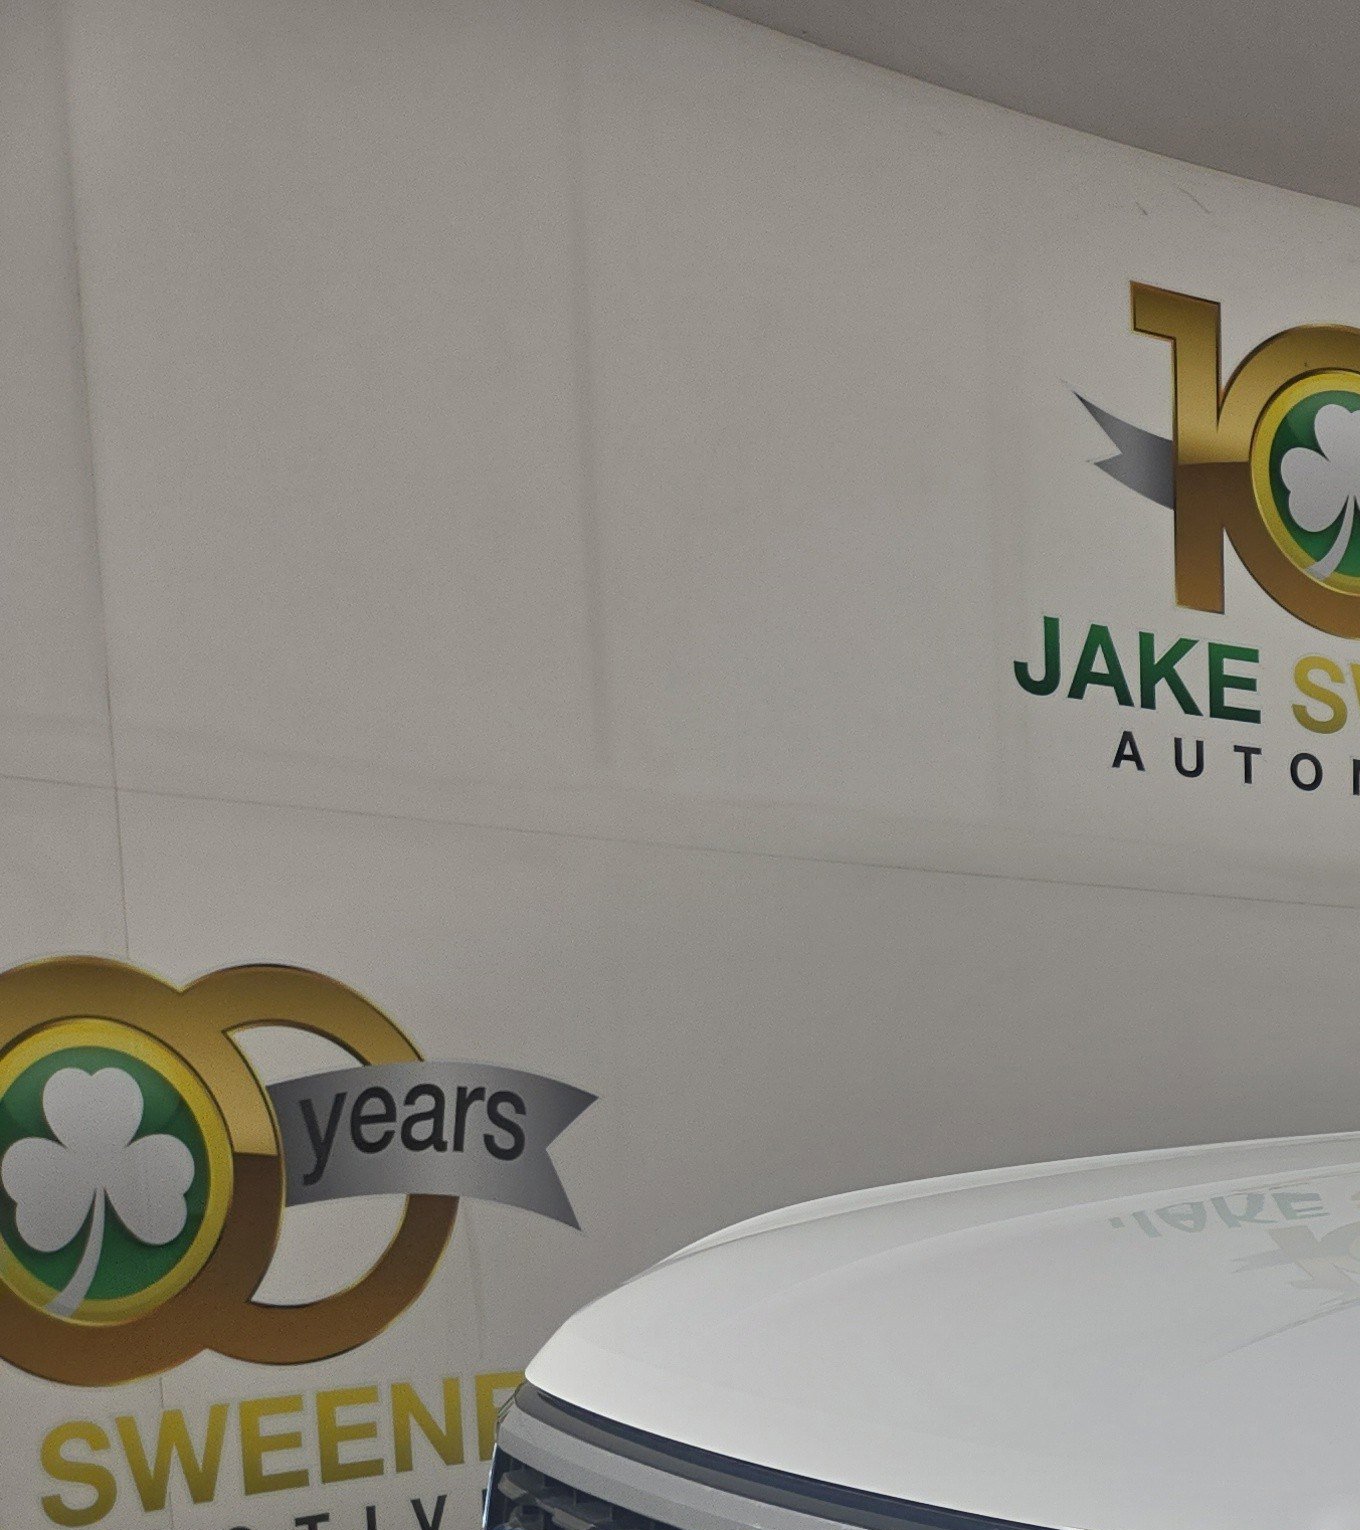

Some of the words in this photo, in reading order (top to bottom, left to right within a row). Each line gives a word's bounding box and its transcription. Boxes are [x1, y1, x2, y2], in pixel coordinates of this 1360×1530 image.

[1012, 615, 1262, 724] JAKE
[300, 1082, 527, 1186] years
[39, 1371, 526, 1527] SWEENE
